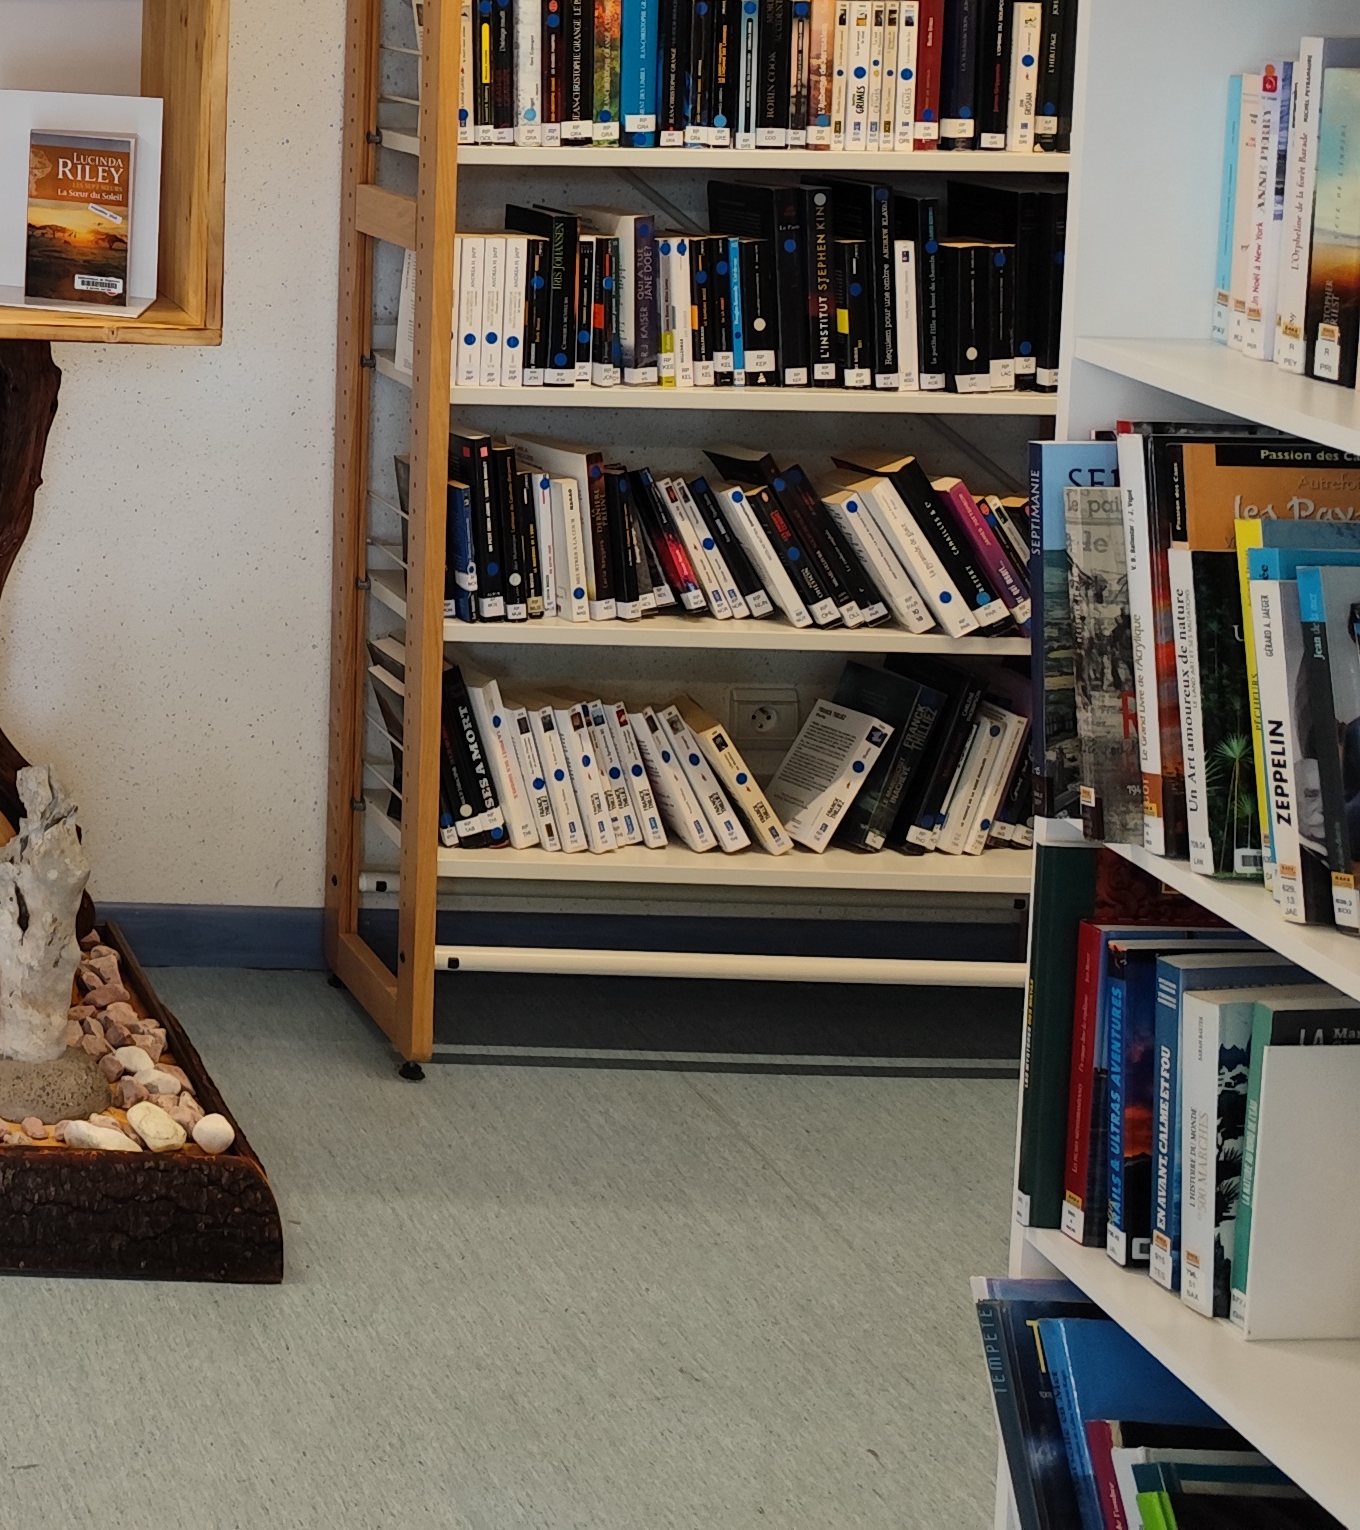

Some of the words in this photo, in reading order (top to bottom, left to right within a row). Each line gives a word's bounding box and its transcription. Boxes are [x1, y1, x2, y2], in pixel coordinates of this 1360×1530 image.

[765, 84, 775, 119] ROBIN
[856, 85, 866, 115] GRIMES
[57, 157, 123, 185] RILEY
[73, 152, 123, 168] LUCINDA
[58, 188, 68, 197] La
[68, 189, 89, 198] Sœur
[90, 190, 101, 200] du
[102, 191, 123, 201] Soleil
[1257, 168, 1271, 214] ANNE
[645, 245, 654, 271] DOE?
[1292, 215, 1303, 271] L'Orpheline
[817, 234, 829, 290] STEPHEN
[645, 272, 653, 300] JANE
[641, 306, 650, 338] KAISER
[819, 295, 830, 358] L'INSTITUT
[884, 330, 893, 365] Requiem
[1260, 449, 1313, 461] Passion
[1316, 450, 1339, 461] des
[1030, 469, 1041, 555] SEPTIMANIE
[1175, 588, 1185, 641] nature
[1261, 594, 1269, 620] JAEGER
[1133, 613, 1143, 673] l'Acrylique
[1179, 646, 1188, 665] de
[1313, 635, 1326, 660] Jean
[1182, 668, 1194, 752] amoureux
[458, 704, 482, 762] MORT
[1140, 724, 1148, 750] Grand
[1188, 756, 1197, 782] Art
[1268, 719, 1292, 827] ZEPPELIN
[1189, 789, 1199, 812] Un
[1110, 985, 1122, 1090] AVENTURES
[1160, 1045, 1171, 1077] FOU
[1109, 1093, 1121, 1157] ULTRAS
[1157, 1098, 1169, 1159] CALME
[1197, 1111, 1209, 1179] MARCHES
